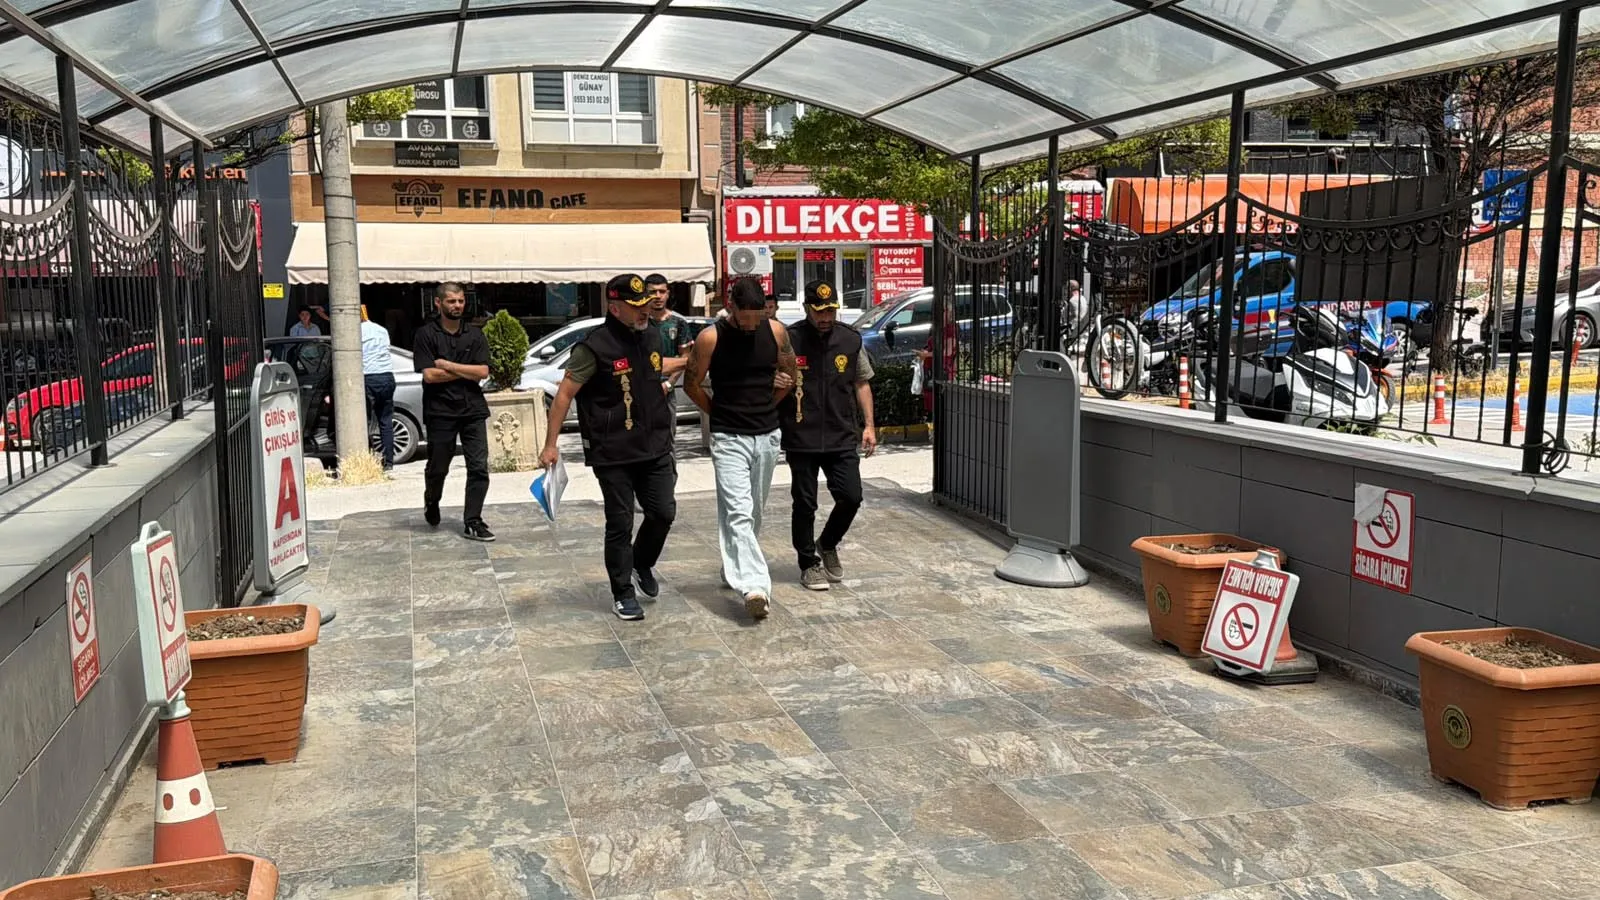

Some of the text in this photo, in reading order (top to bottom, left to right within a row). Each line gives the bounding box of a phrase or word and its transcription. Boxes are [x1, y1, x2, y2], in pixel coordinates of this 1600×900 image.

[412, 88, 440, 100] ÜROSU
[579, 81, 603, 91] GÜNAY
[408, 144, 446, 152] AVUKAT
[399, 196, 438, 207] EFANO
[457, 188, 587, 210] EFANO CAFE
[736, 199, 900, 239] DİLEKÇE
[878, 247, 917, 256] FOTOKOPİ
[878, 256, 917, 266] DİLEKÇE
[876, 280, 898, 291] SEBİL
[264, 407, 297, 428] GİRİŞ ve
[264, 429, 300, 456] ÇIKIŞLAR
[274, 456, 301, 530] A
[1355, 550, 1408, 589] SİGARA İÇİLMEZ
[1225, 566, 1284, 601] SİGARA İÇİLMEZ
